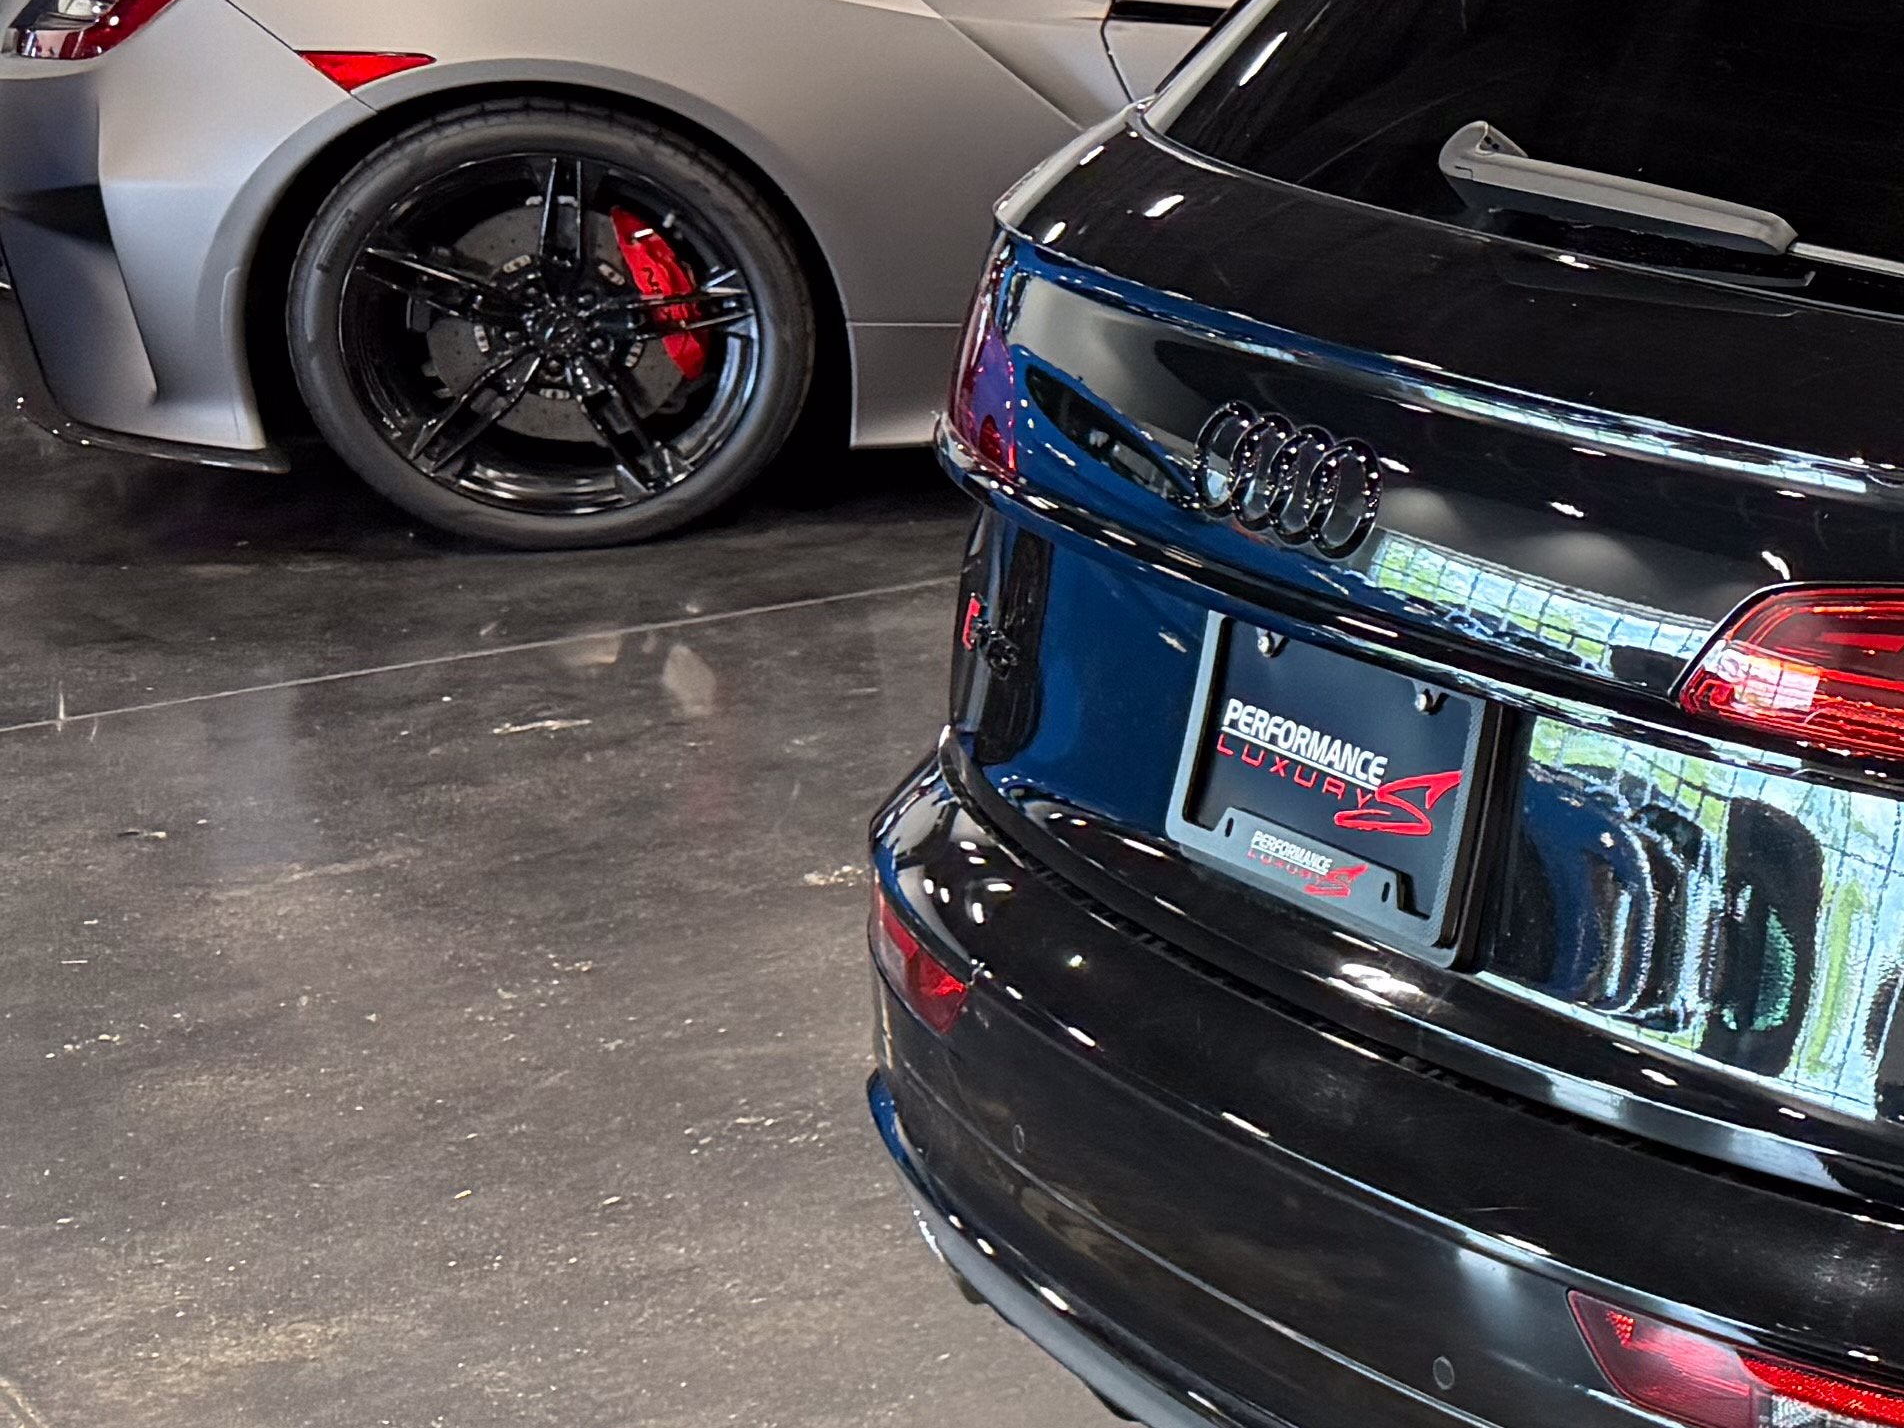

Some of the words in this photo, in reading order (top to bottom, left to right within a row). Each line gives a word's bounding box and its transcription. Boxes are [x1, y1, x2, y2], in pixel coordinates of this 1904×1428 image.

[1216, 734, 1374, 809] LUXURY
[1223, 698, 1388, 786] PERFORMANCE
[1251, 830, 1333, 871] PERFORMANCE
